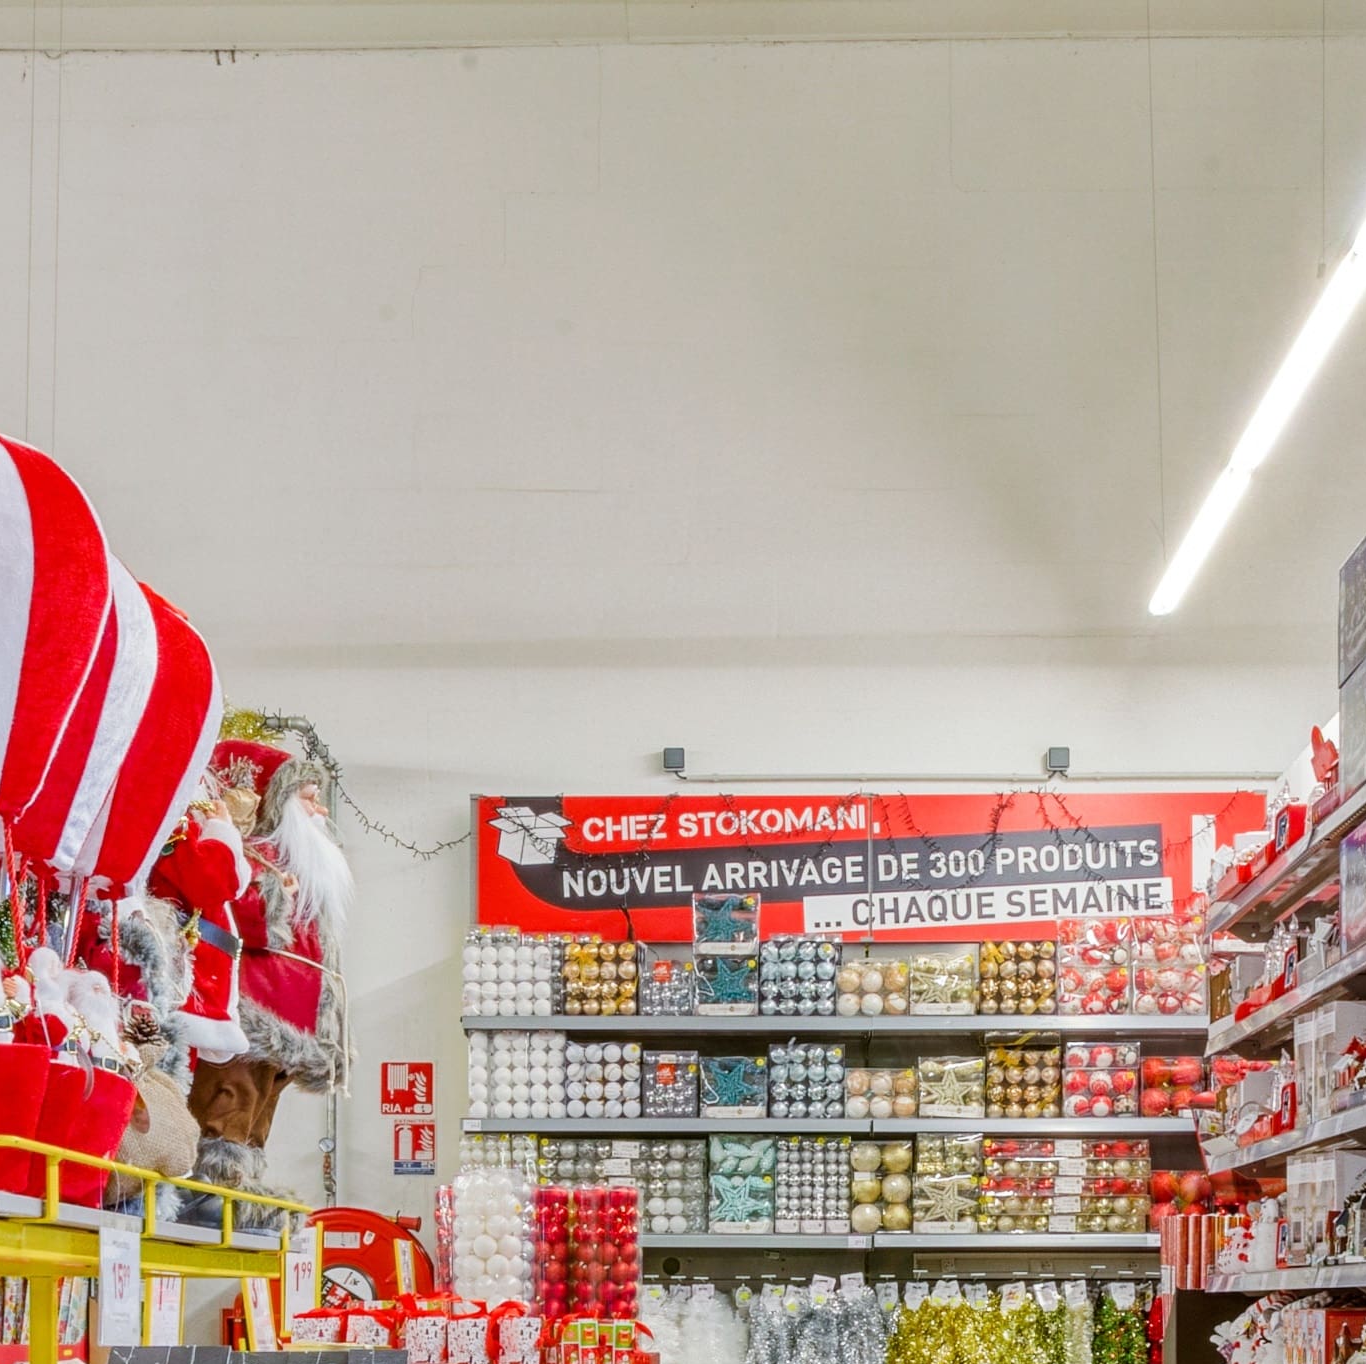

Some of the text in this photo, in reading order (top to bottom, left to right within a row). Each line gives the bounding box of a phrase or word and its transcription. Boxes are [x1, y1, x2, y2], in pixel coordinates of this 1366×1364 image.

[582, 813, 667, 843] CHEZ
[562, 839, 1159, 898] NOUVEL ARRIVAGE DE 300 PRODUITS
[852, 892, 996, 925] CHAQUE
[1005, 882, 1163, 917] SEMAINE
[382, 1104, 402, 1113] RIA
